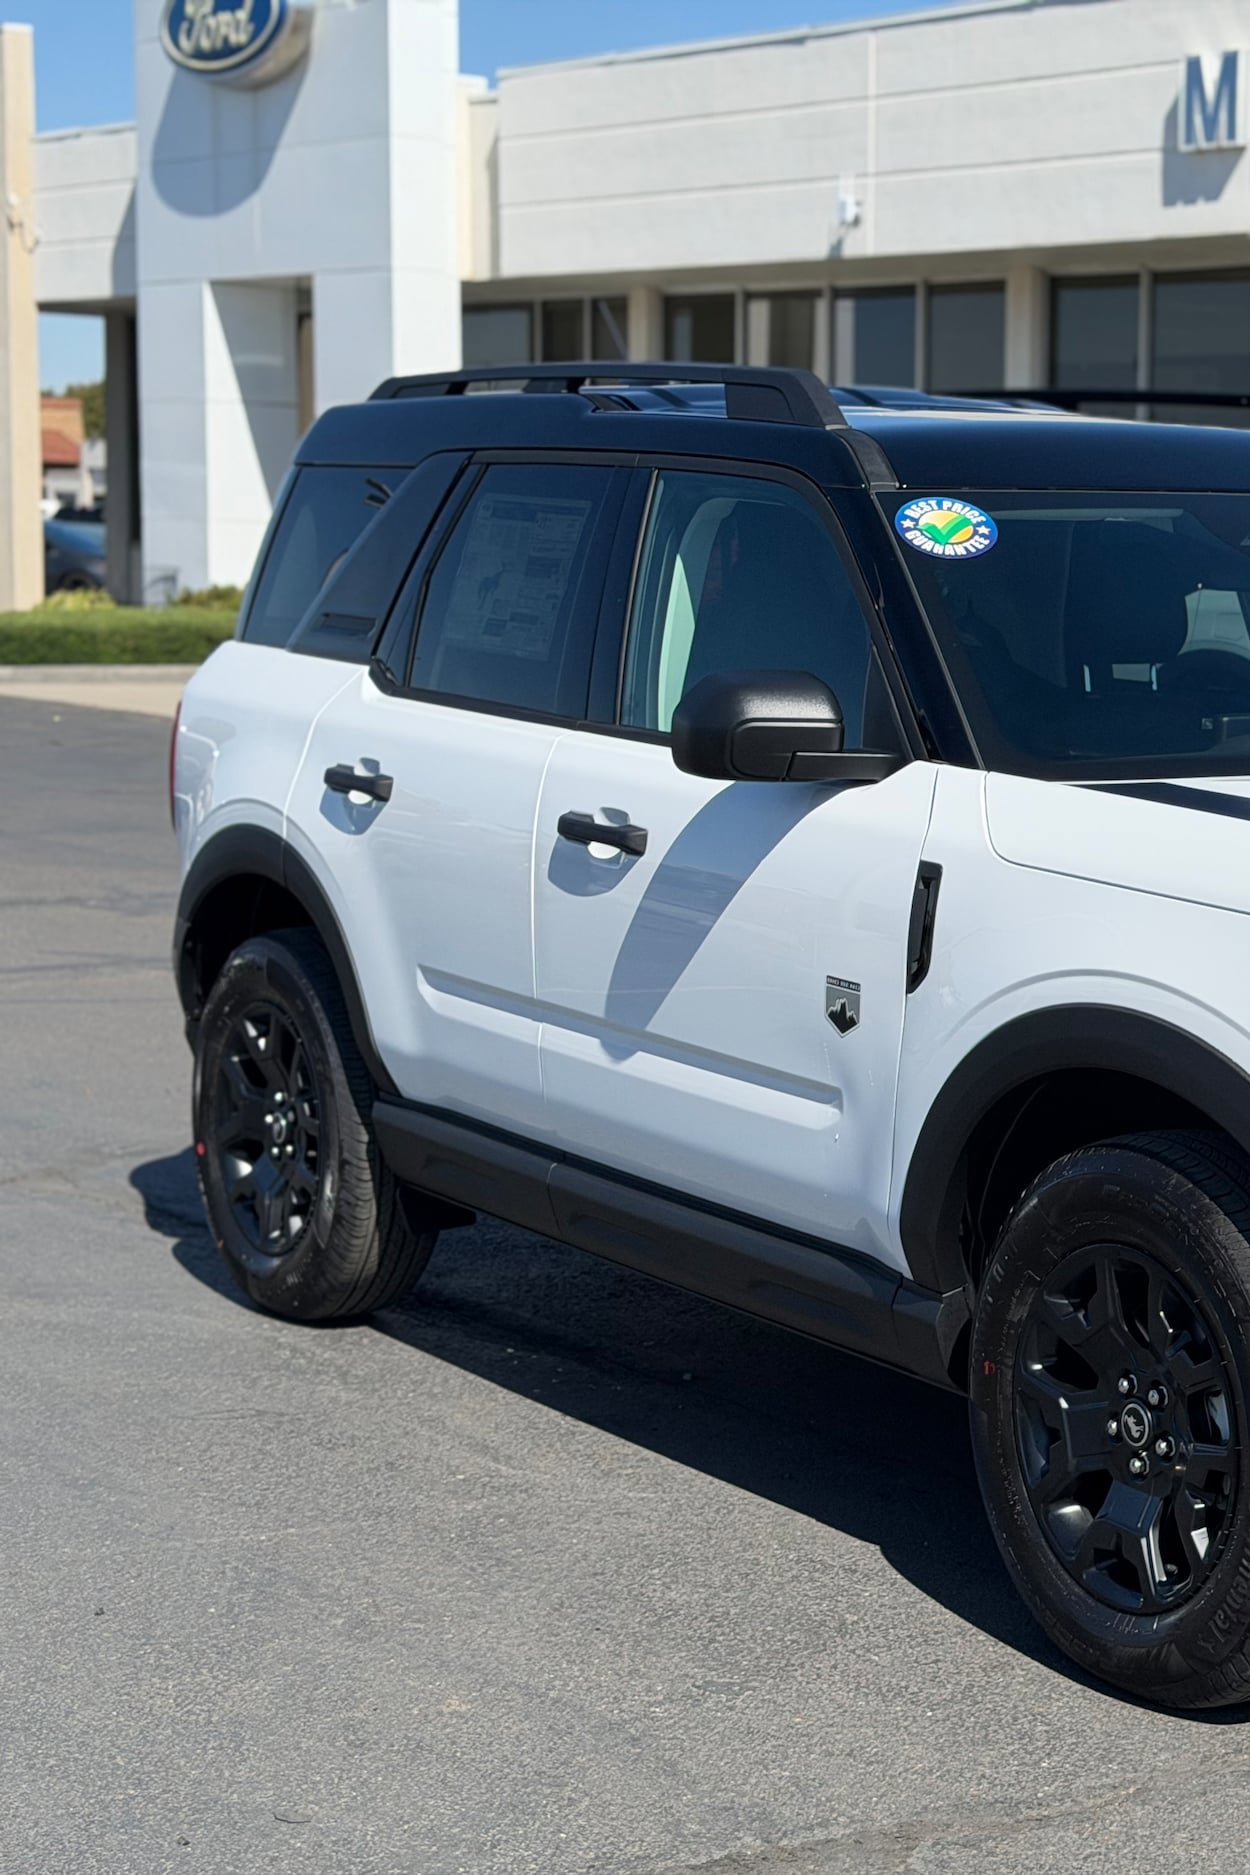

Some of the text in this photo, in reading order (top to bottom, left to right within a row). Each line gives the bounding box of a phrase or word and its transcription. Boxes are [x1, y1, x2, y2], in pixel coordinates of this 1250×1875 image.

[178, 0, 255, 55] Ford
[903, 500, 987, 525] BEST PRICE
[905, 530, 990, 556] GUARANTEE
